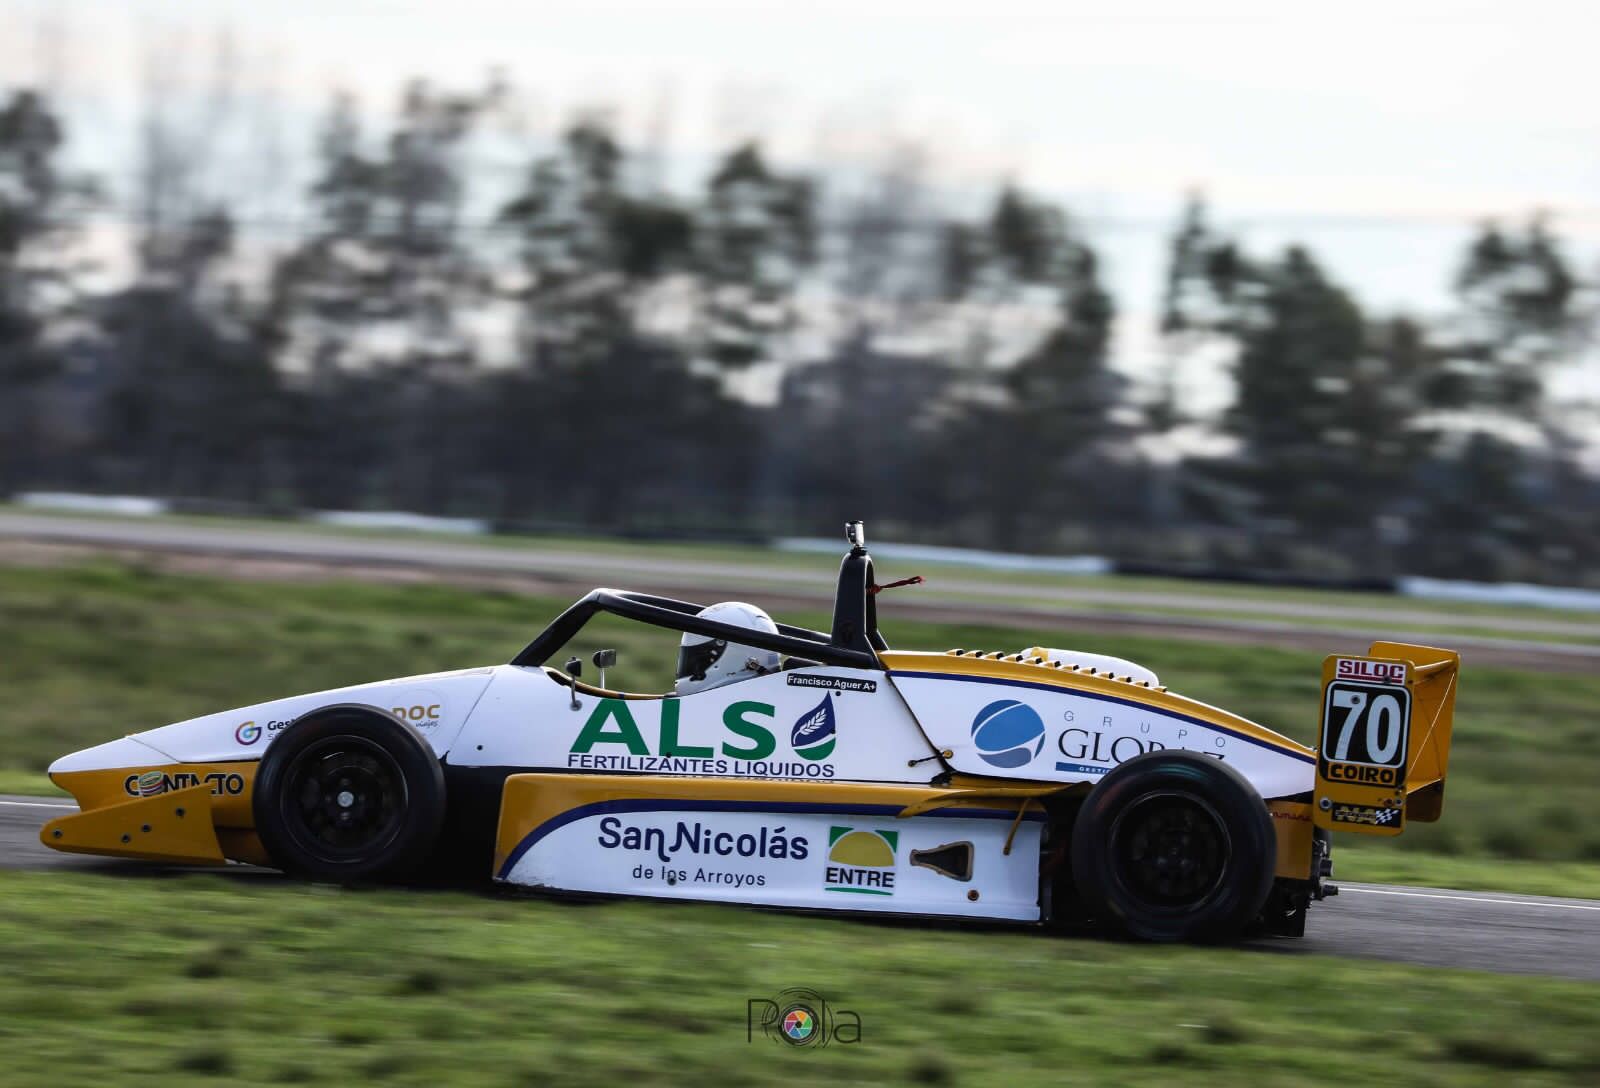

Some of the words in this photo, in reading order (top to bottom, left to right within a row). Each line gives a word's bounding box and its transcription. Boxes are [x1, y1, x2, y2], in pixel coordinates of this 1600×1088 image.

[1338, 660, 1404, 679] SILOC
[787, 675, 832, 687] Francisco
[834, 679, 861, 690] Aguer
[863, 682, 875, 690] A+
[569, 699, 777, 761] ALS
[1332, 689, 1401, 764] 70
[567, 754, 727, 774] FERTILIZANTES
[734, 761, 835, 778] LIQUIDOS
[1330, 764, 1394, 783] COIRO
[632, 864, 654, 879] de
[661, 866, 688, 882] los
[694, 867, 766, 888] Arroyos
[825, 867, 895, 889] ENTRE
